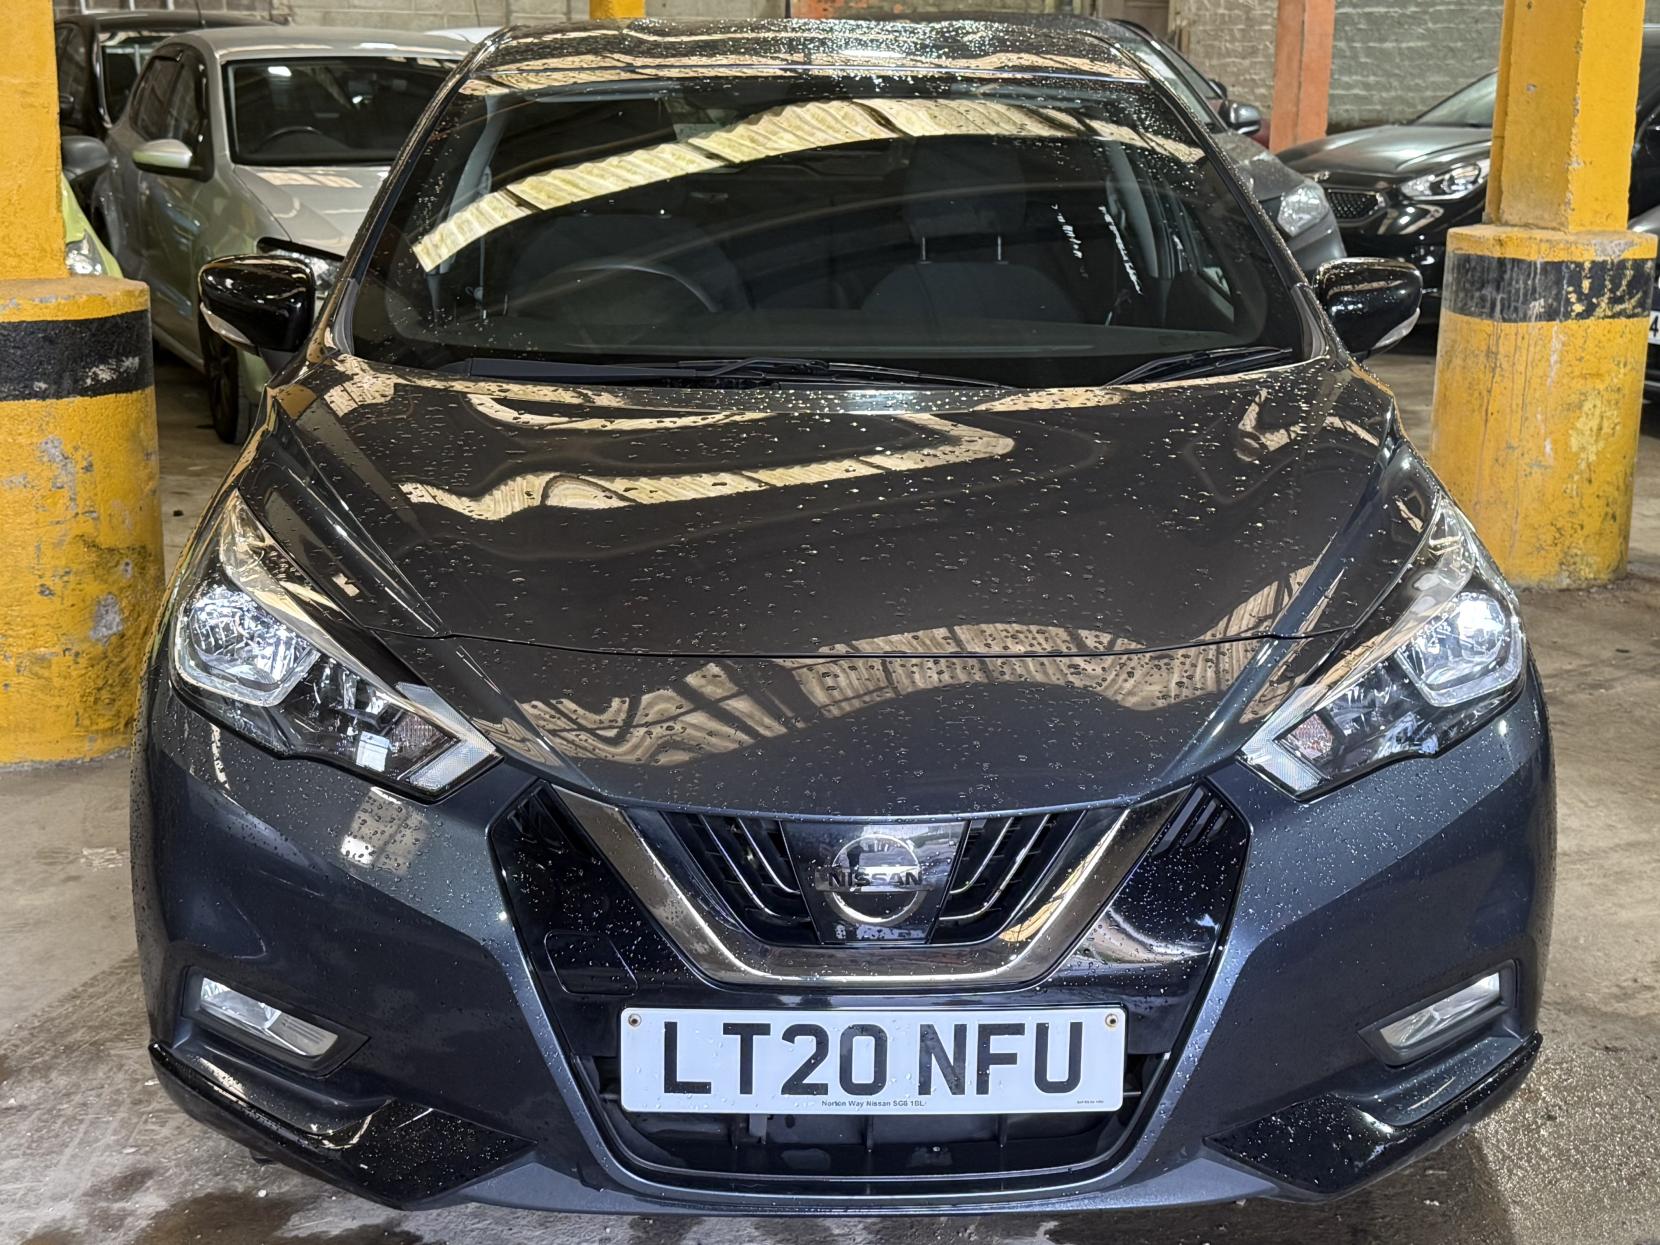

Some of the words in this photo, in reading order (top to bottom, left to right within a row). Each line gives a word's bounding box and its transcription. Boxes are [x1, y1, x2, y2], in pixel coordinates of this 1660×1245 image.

[828, 871, 923, 887] NISSAN
[664, 1021, 887, 1096] LT20
[918, 1021, 1083, 1095] NFU
[848, 1100, 864, 1109] Way
[866, 1099, 891, 1107] Nissan
